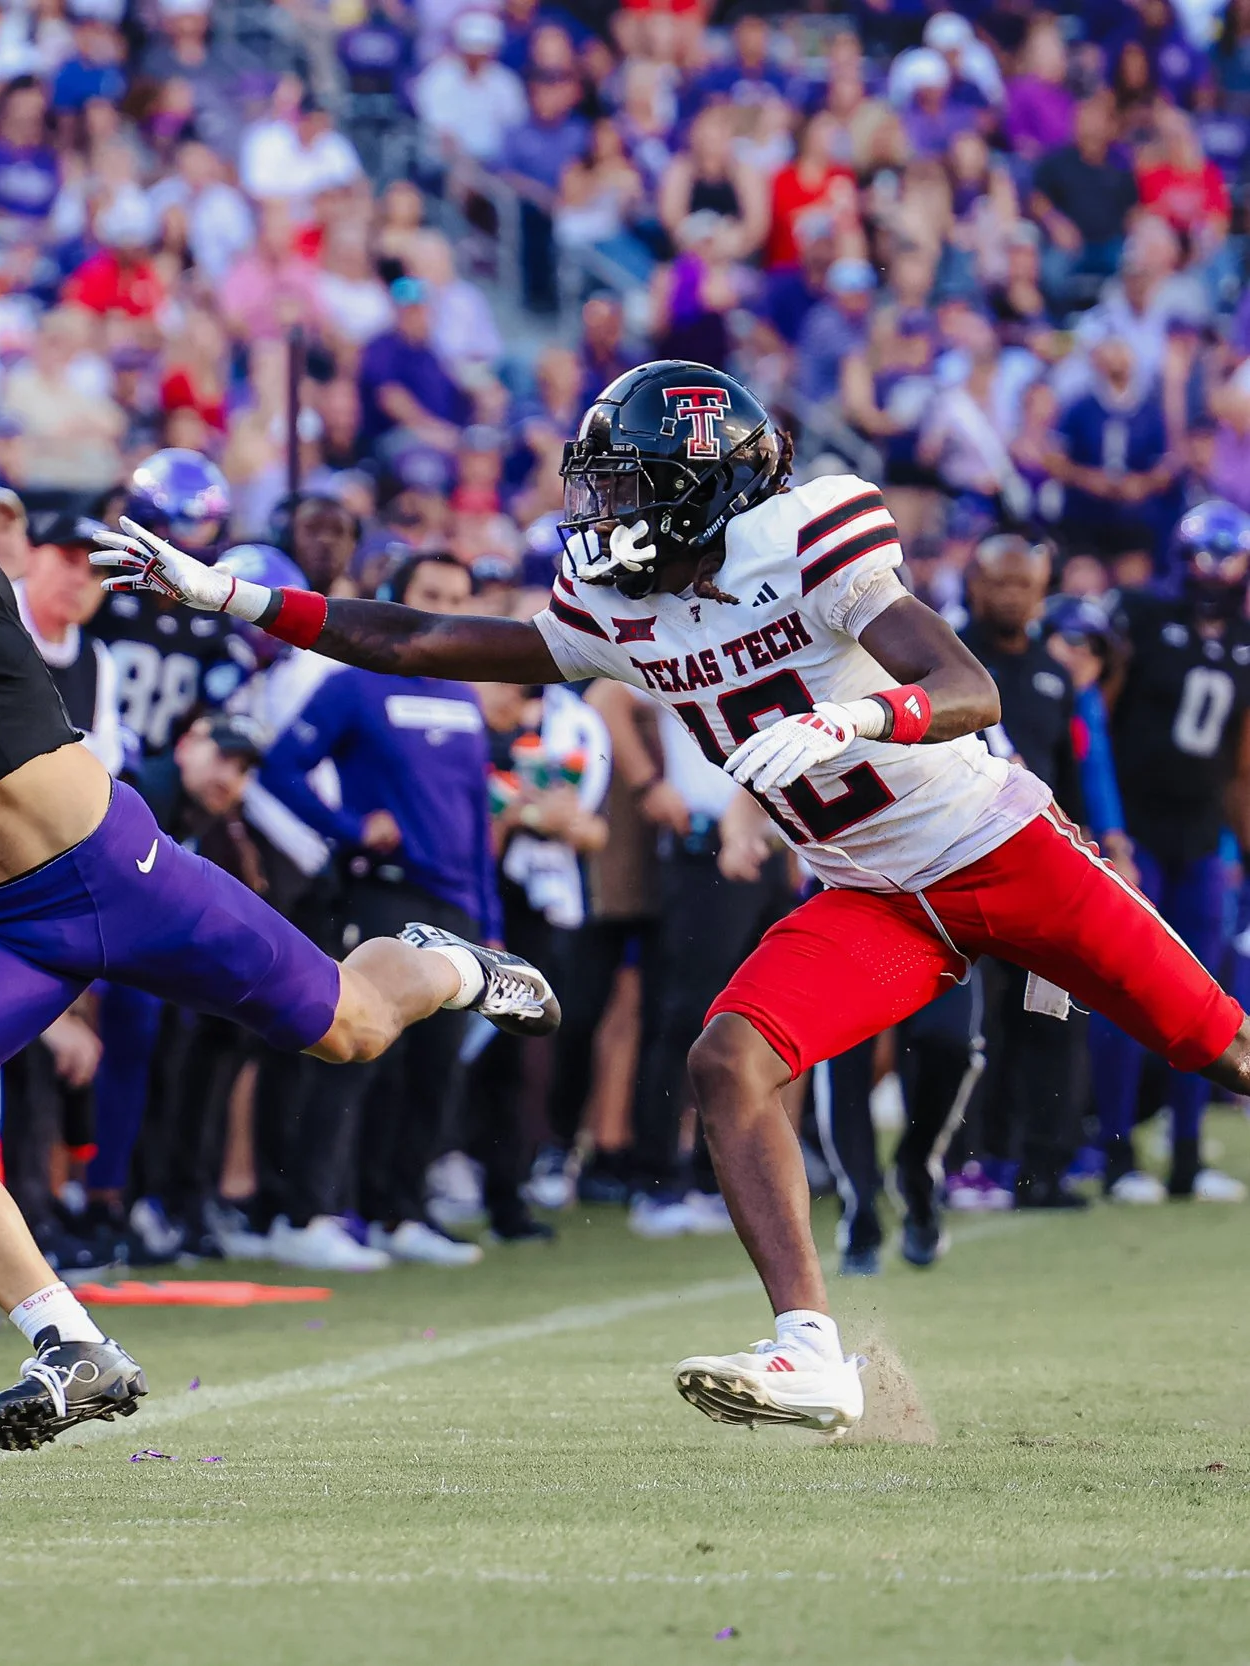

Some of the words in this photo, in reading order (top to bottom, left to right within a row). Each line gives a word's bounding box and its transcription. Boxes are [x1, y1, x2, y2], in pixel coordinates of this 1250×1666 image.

[629, 648, 724, 693] TEXAS
[720, 610, 814, 677] TECH
[672, 668, 898, 846] 12
